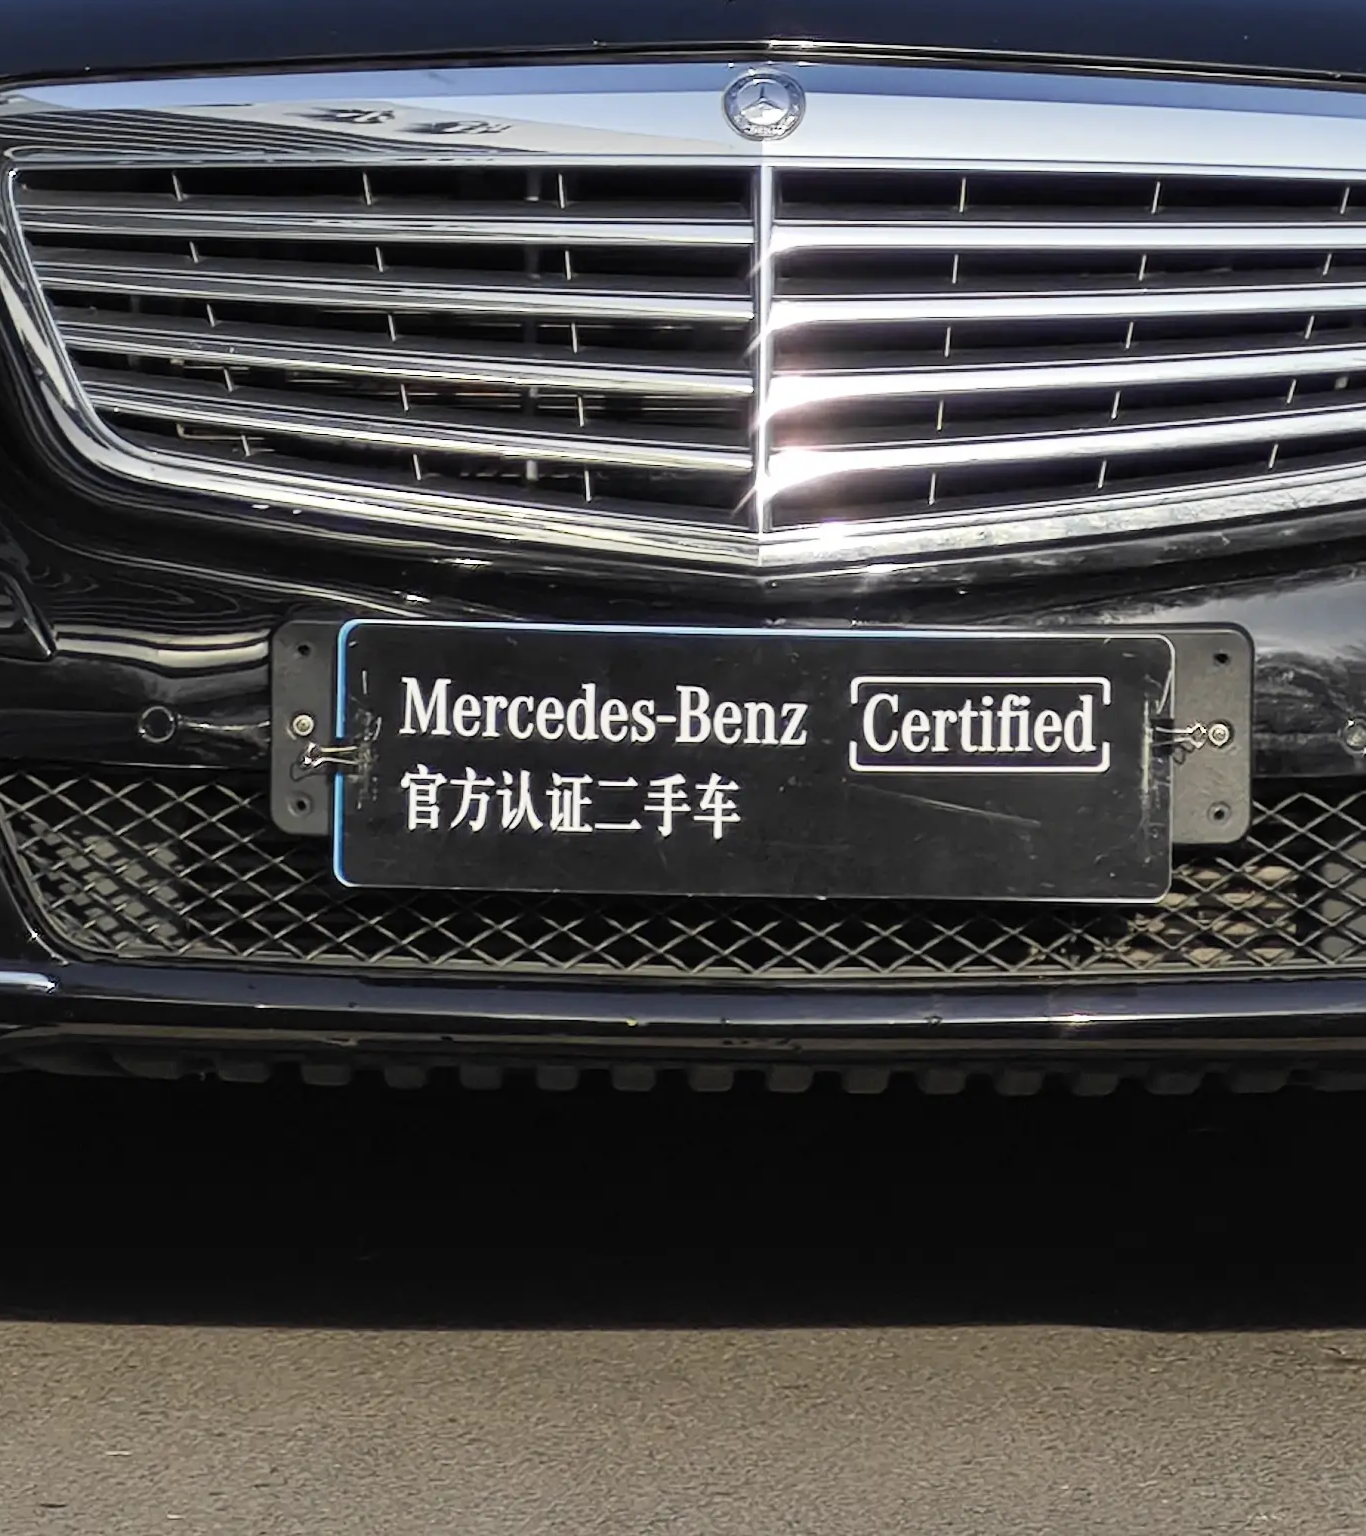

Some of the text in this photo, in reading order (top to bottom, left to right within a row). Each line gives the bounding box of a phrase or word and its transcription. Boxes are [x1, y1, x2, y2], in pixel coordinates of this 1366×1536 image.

[398, 676, 1097, 753] Mercedes-Benz Certified
[400, 763, 742, 840] 官方认证二手车
